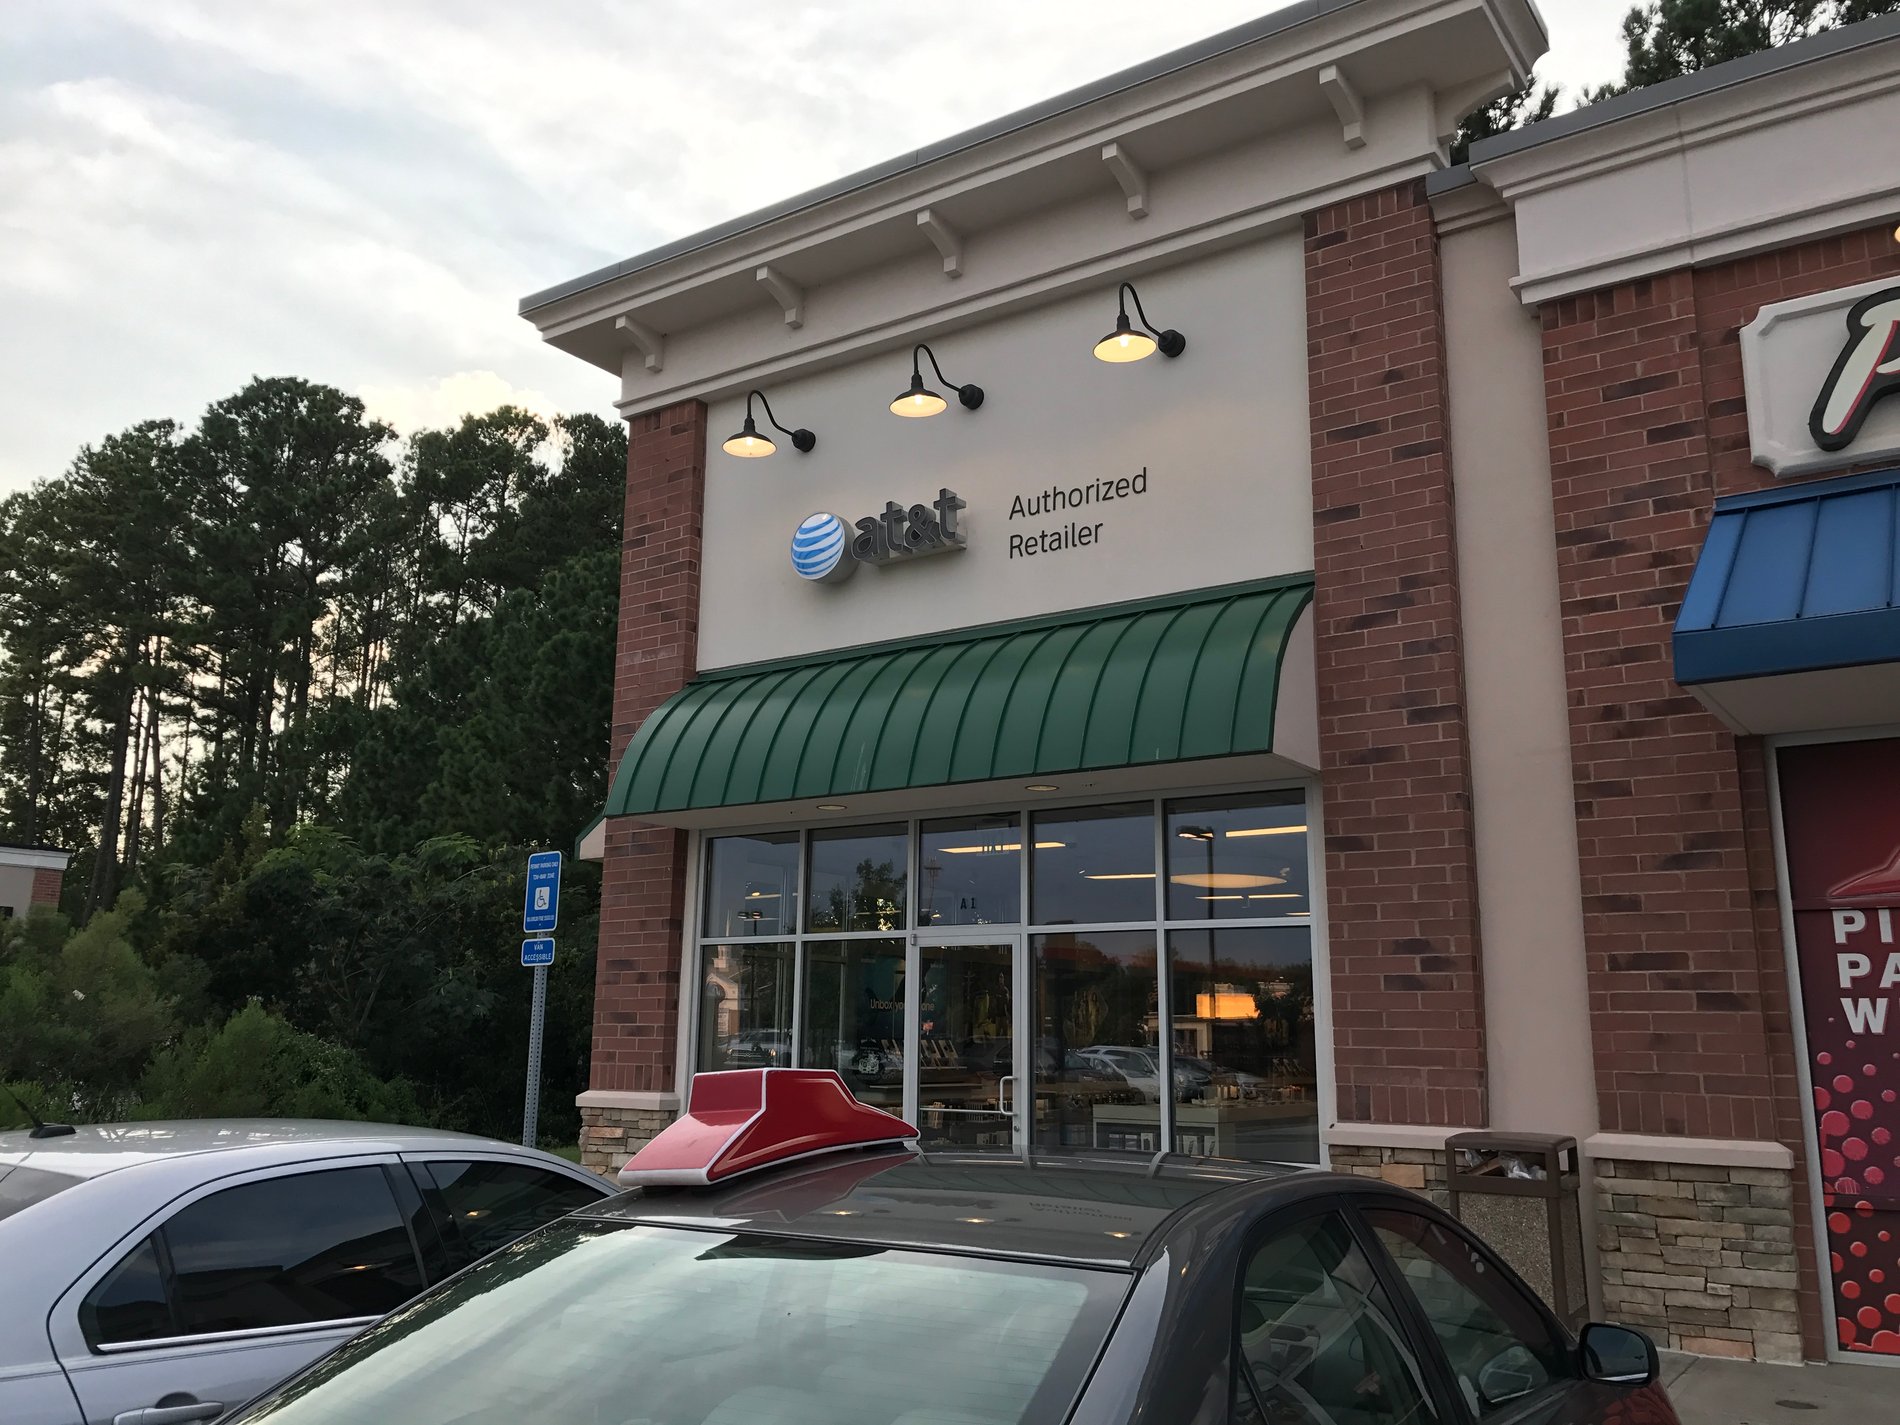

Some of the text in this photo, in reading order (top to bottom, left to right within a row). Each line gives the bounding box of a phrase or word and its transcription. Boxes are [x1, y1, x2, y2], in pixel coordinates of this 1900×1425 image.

[1009, 467, 1147, 520] Authorized
[852, 488, 967, 562] at&t
[1009, 522, 1104, 559] Retailer
[524, 953, 551, 961] ACCESSIBLE
[870, 999, 893, 1009] Unbox
